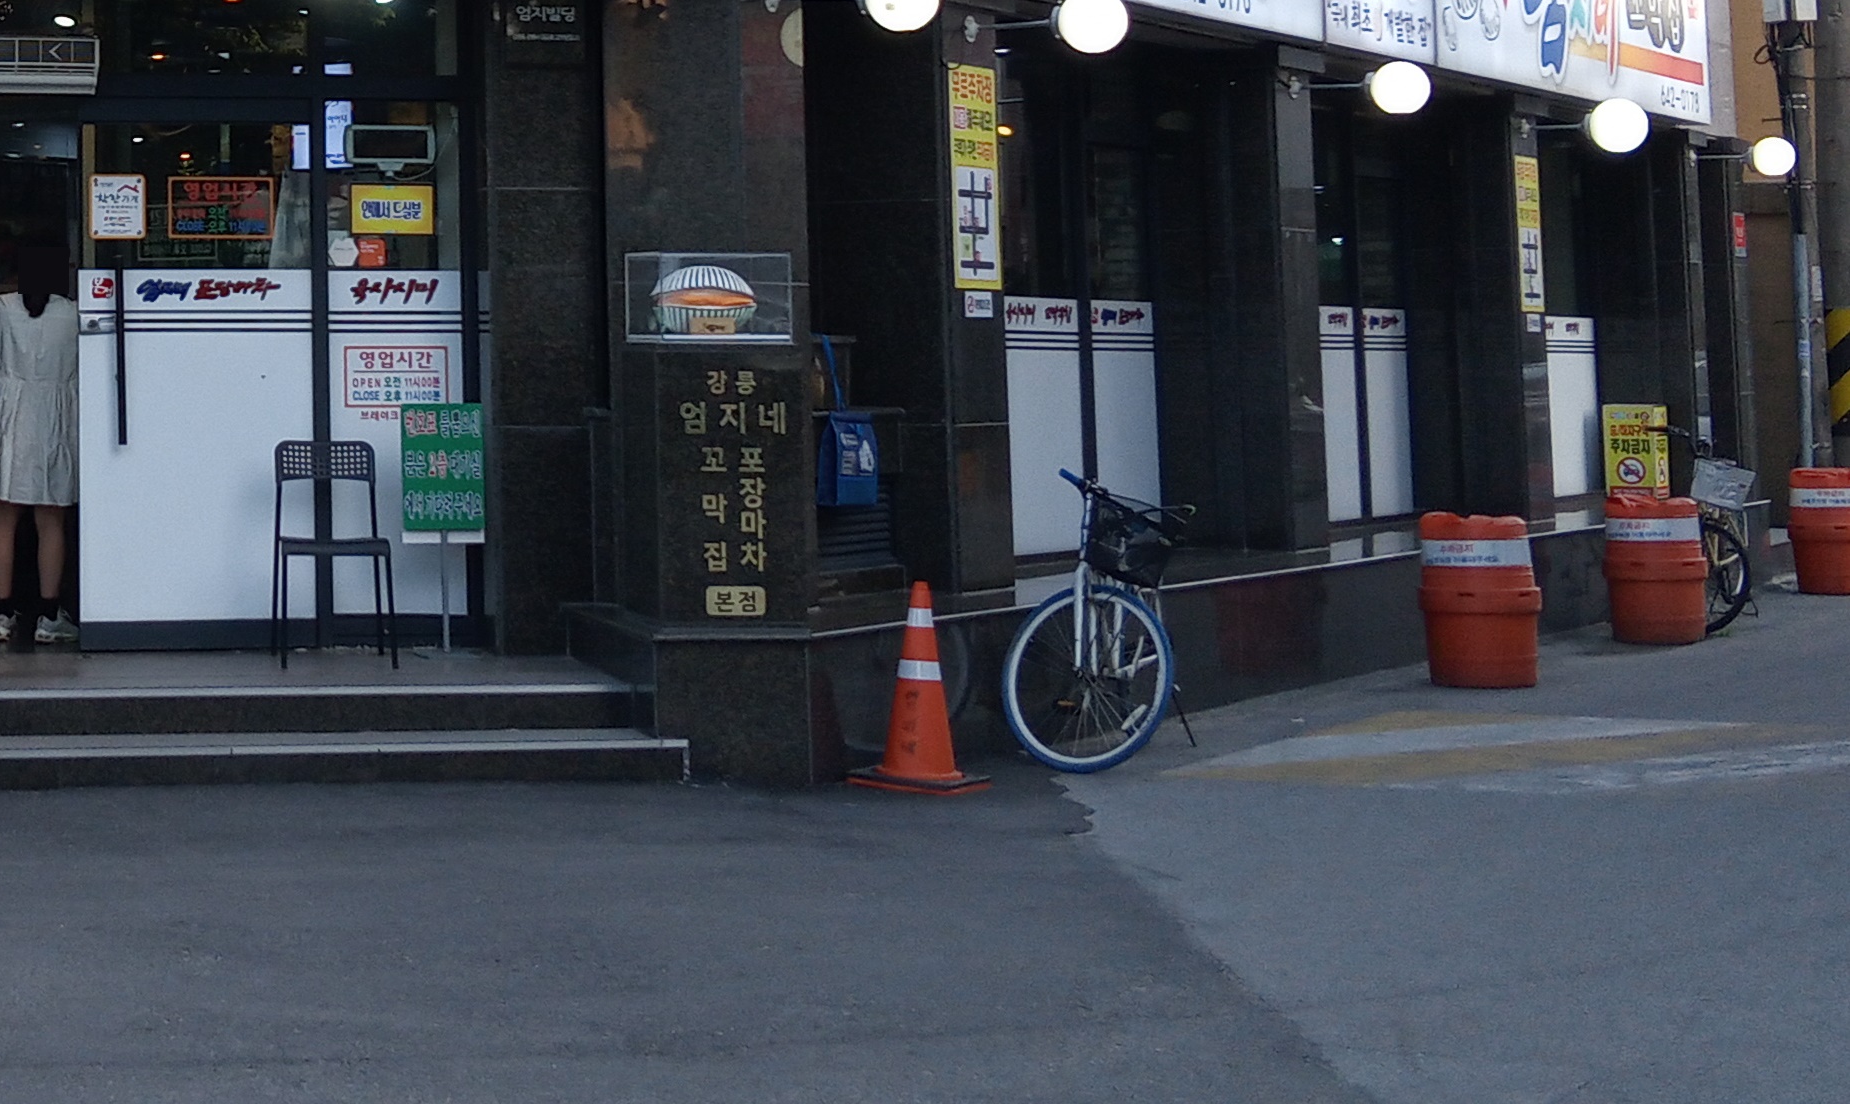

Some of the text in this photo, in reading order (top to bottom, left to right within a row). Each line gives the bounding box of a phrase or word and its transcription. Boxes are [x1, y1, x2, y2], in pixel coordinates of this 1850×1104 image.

[516, 5, 575, 22] 엄지빌딩
[393, 200, 422, 219] 드실분
[359, 351, 433, 369] 영업시간
[352, 378, 381, 388] OPEN
[384, 377, 401, 388] 오전
[706, 370, 758, 395] 강릉
[352, 390, 381, 401] CLOSE
[383, 390, 401, 402] 오후
[679, 401, 787, 436] 엄지네
[1610, 438, 1650, 454] 주차금지
[700, 447, 729, 572] 꼬막집
[738, 446, 768, 572] 포장마차
[713, 589, 760, 614] 본점
